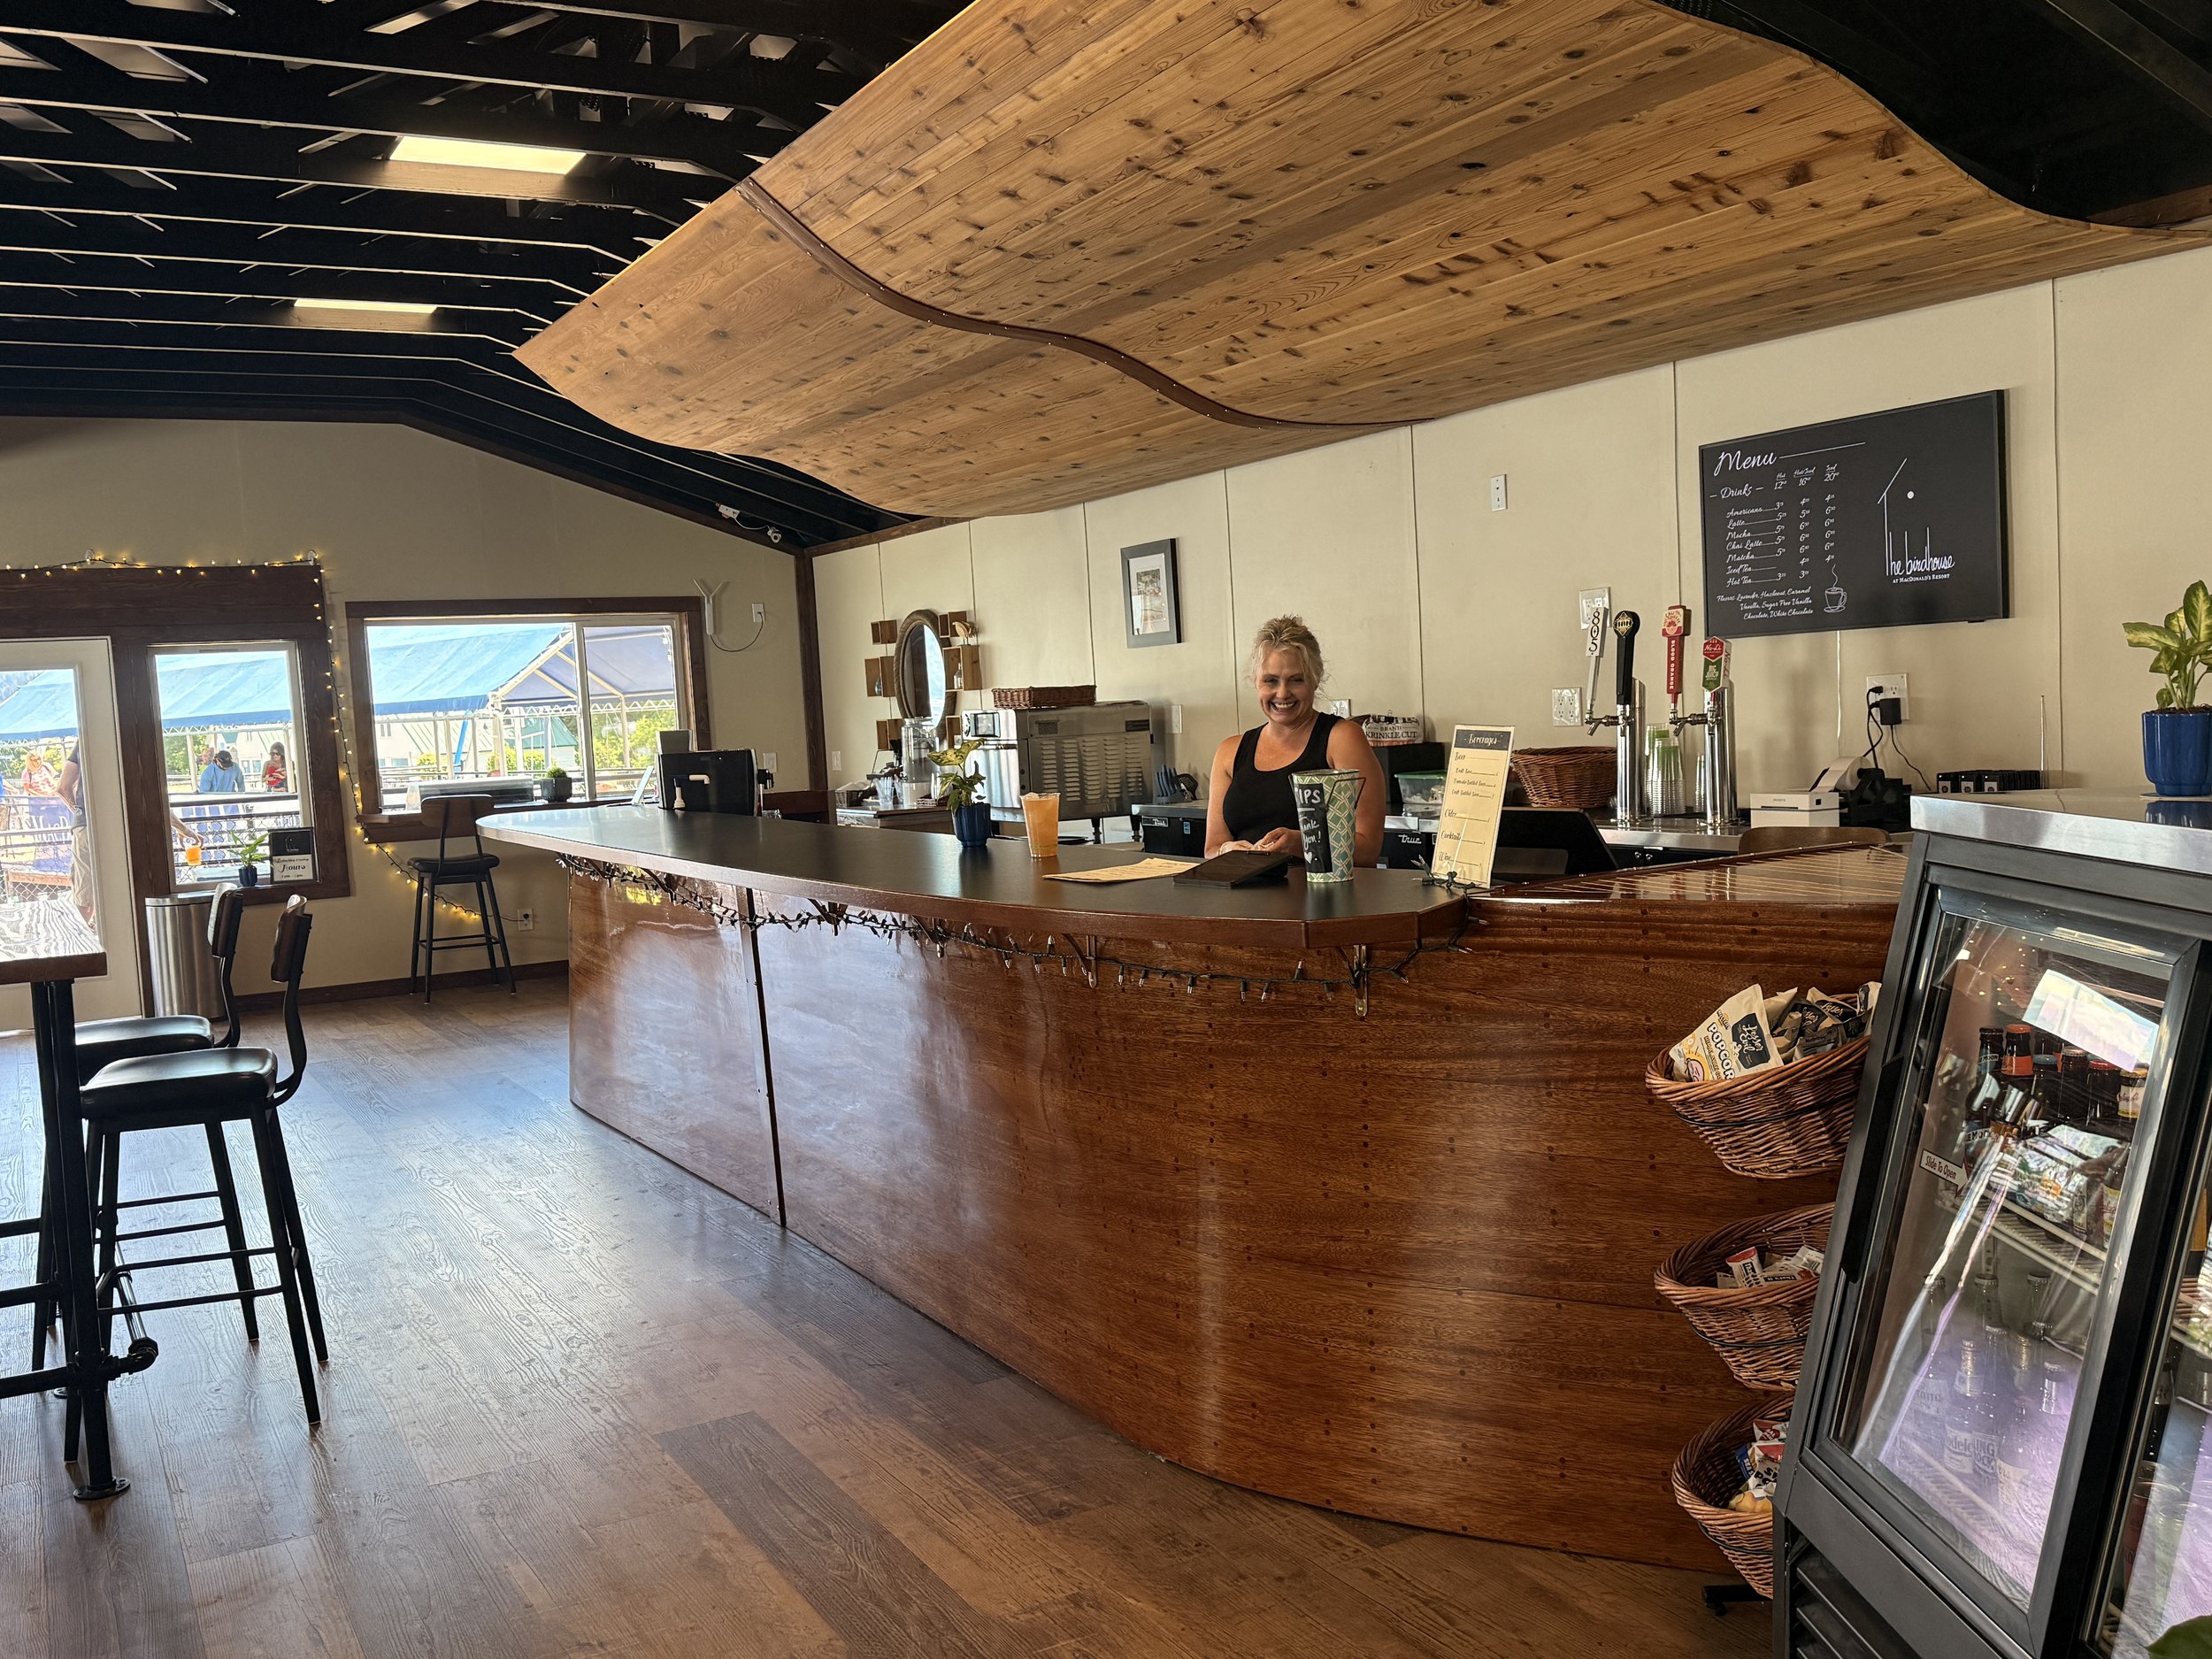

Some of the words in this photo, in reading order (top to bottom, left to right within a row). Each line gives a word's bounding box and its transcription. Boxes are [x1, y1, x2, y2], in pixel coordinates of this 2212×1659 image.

[1713, 450, 1778, 477] Menu
[1720, 483, 1753, 499] Drinks
[1725, 504, 1763, 518] Americano
[1727, 518, 1745, 530] Latte
[1725, 529, 1751, 541] Mocha
[1726, 541, 1743, 550] Chai
[1744, 539, 1763, 550] Latte
[1904, 526, 1955, 575] birdhouse
[1726, 551, 1755, 564] Matcha
[1726, 565, 1741, 575] Iced
[1741, 564, 1752, 572] Tea
[1726, 577, 1740, 588] Hot
[1741, 575, 1752, 584] Tea
[1787, 586, 1812, 595] Caramel
[1787, 607, 1814, 617] Chocolate
[1588, 611, 1601, 653] 805
[1468, 733, 1498, 746] Beverages
[1444, 809, 1457, 818] Cider
[1740, 1033, 1756, 1054] Evil
[1742, 1024, 1764, 1052] Lesser
[1707, 1022, 1736, 1079] POPCOR
[1925, 1156, 1938, 1170] Slide
[1938, 1161, 1944, 1172] To
[1943, 1164, 1956, 1179] Open
